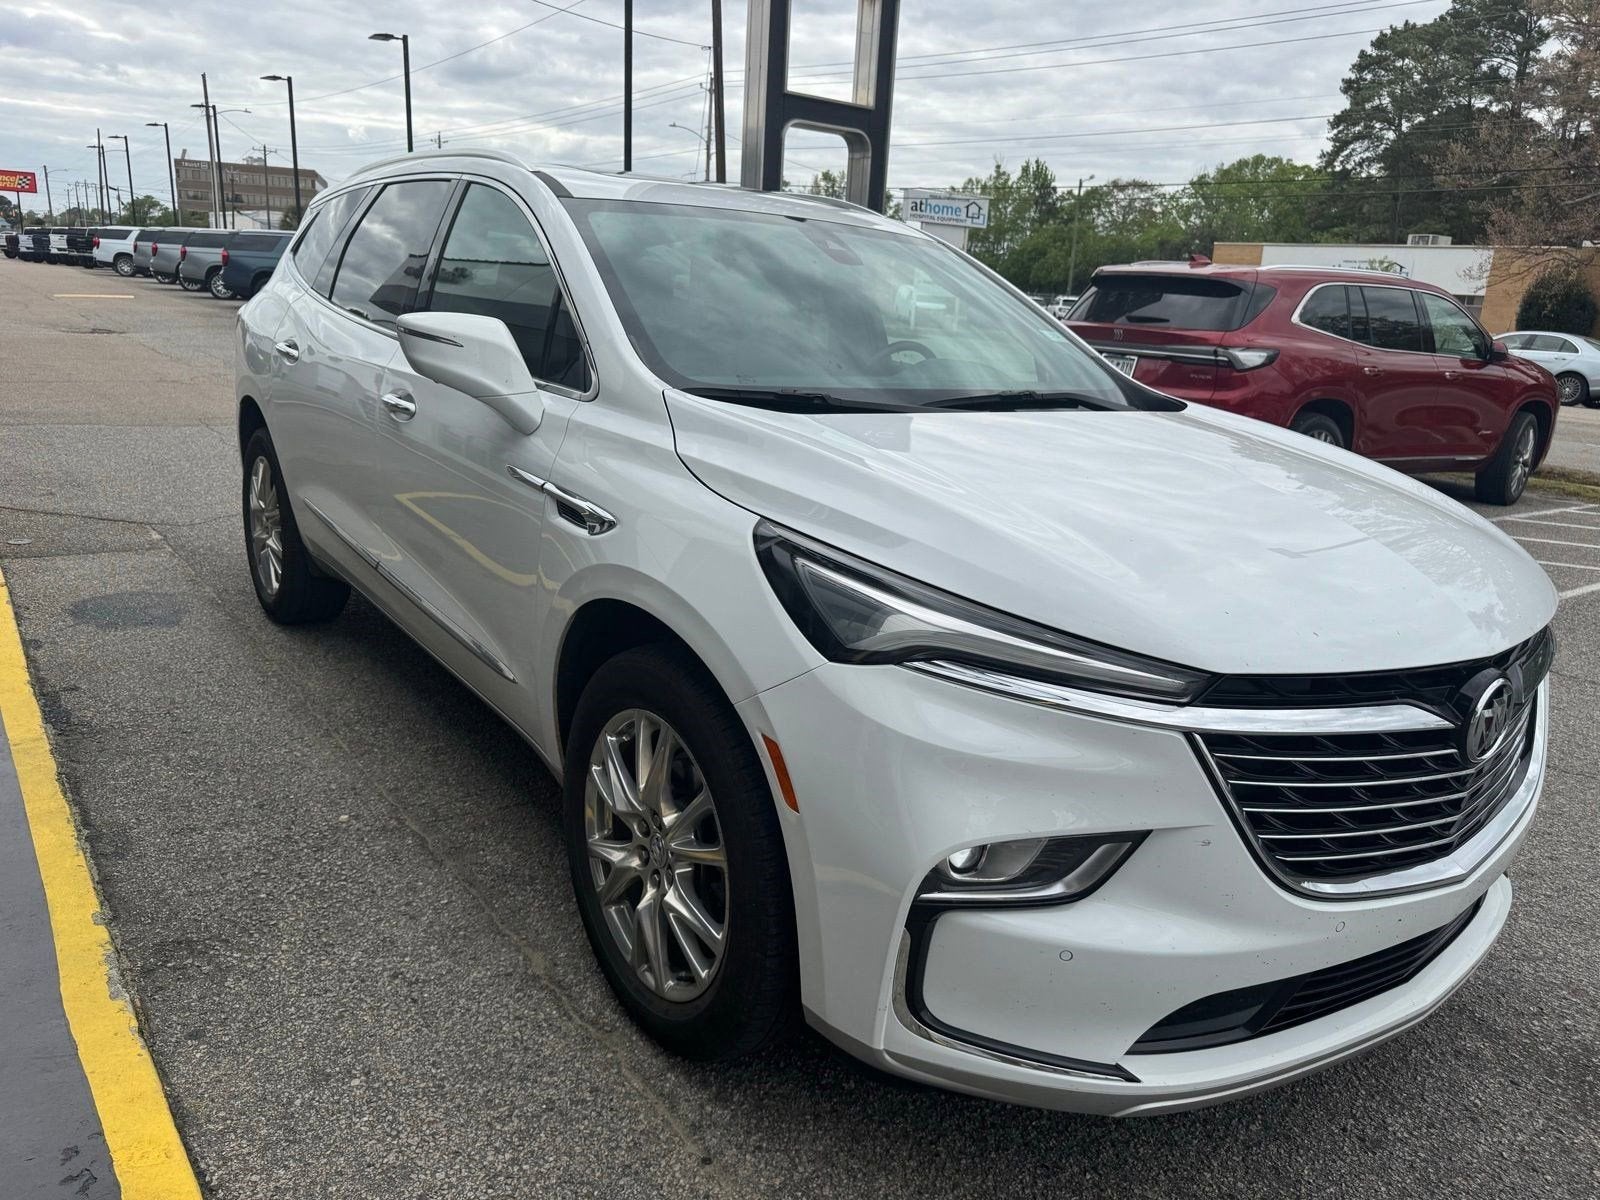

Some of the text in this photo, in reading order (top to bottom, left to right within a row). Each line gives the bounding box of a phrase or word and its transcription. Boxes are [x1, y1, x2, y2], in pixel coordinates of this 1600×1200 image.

[910, 198, 962, 217] athome
[909, 212, 968, 223] HOSPITAL EQUIPMENT
